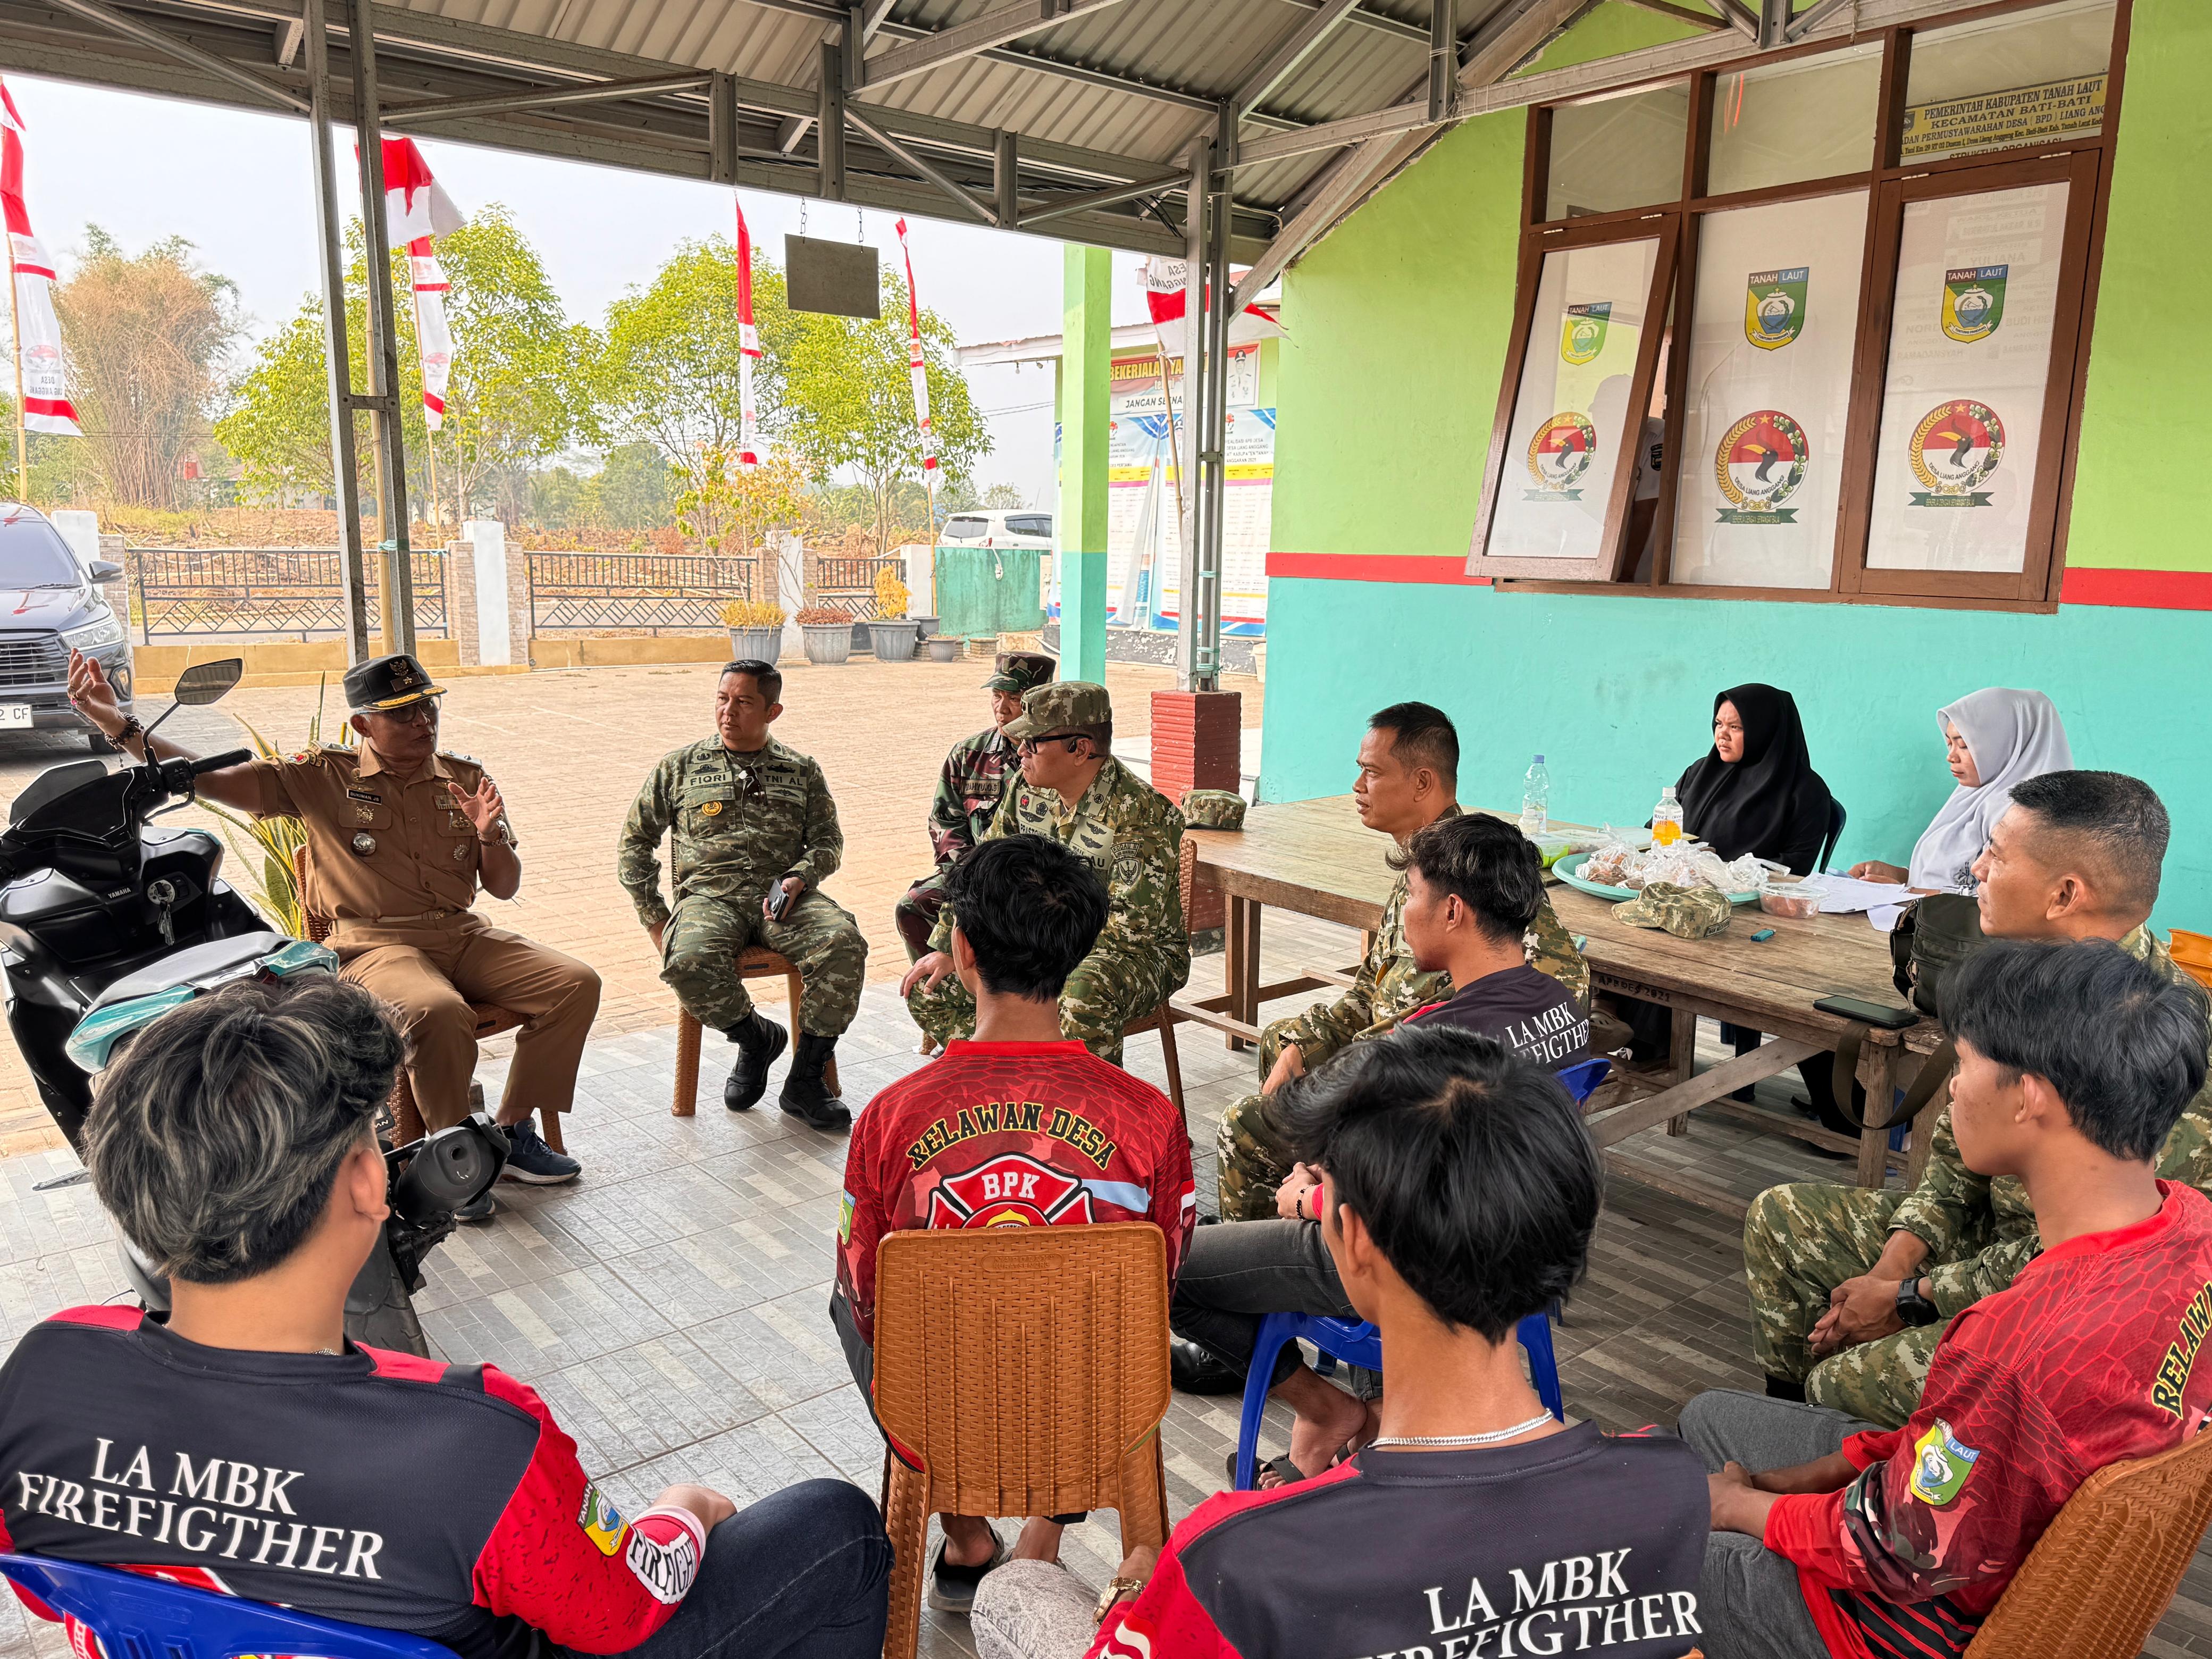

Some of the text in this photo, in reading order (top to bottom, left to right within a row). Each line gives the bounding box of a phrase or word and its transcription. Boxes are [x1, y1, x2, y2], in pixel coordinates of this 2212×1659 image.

[1924, 80, 2102, 120] PEMERINTAH KABUPATEN TANAH LAUT
[1930, 96, 2092, 129] KECAMATAN BATI-BATI
[1922, 121, 2004, 142] PERMUSYAWARAHAN
[2006, 118, 2027, 129] DESA
[2035, 113, 2052, 124] BPD
[2059, 108, 2086, 120] LIANG
[1750, 271, 1804, 284] TANAH LAUT
[1947, 267, 2004, 281] TANAH LAUT
[1110, 361, 1164, 382] BEKERJALA
[1126, 397, 1156, 408] JANGAN
[1929, 462, 1939, 475] DESA
[1955, 460, 1980, 479] ANGGANG
[1735, 476, 1746, 491] DESA
[1761, 475, 1784, 495] ANGGANG
[13, 708, 29, 719] CF
[690, 774, 726, 786] FIQRI
[764, 775, 803, 786] TNI AL
[1113, 843, 1131, 851] KODAU
[107, 887, 131, 899] YAMAHA
[1644, 987, 1670, 1002] 2021
[1505, 1002, 1577, 1049] LA MBK
[905, 1101, 1118, 1171] RELAWAN DESA
[981, 1171, 1041, 1201] BPK
[1950, 1442, 1977, 1460] LAUT
[90, 1437, 305, 1516] LA MBK
[579, 1484, 593, 1524] TANAH
[18, 1471, 384, 1580] FIREFIGTHER
[1423, 1547, 1632, 1635] LA MBK
